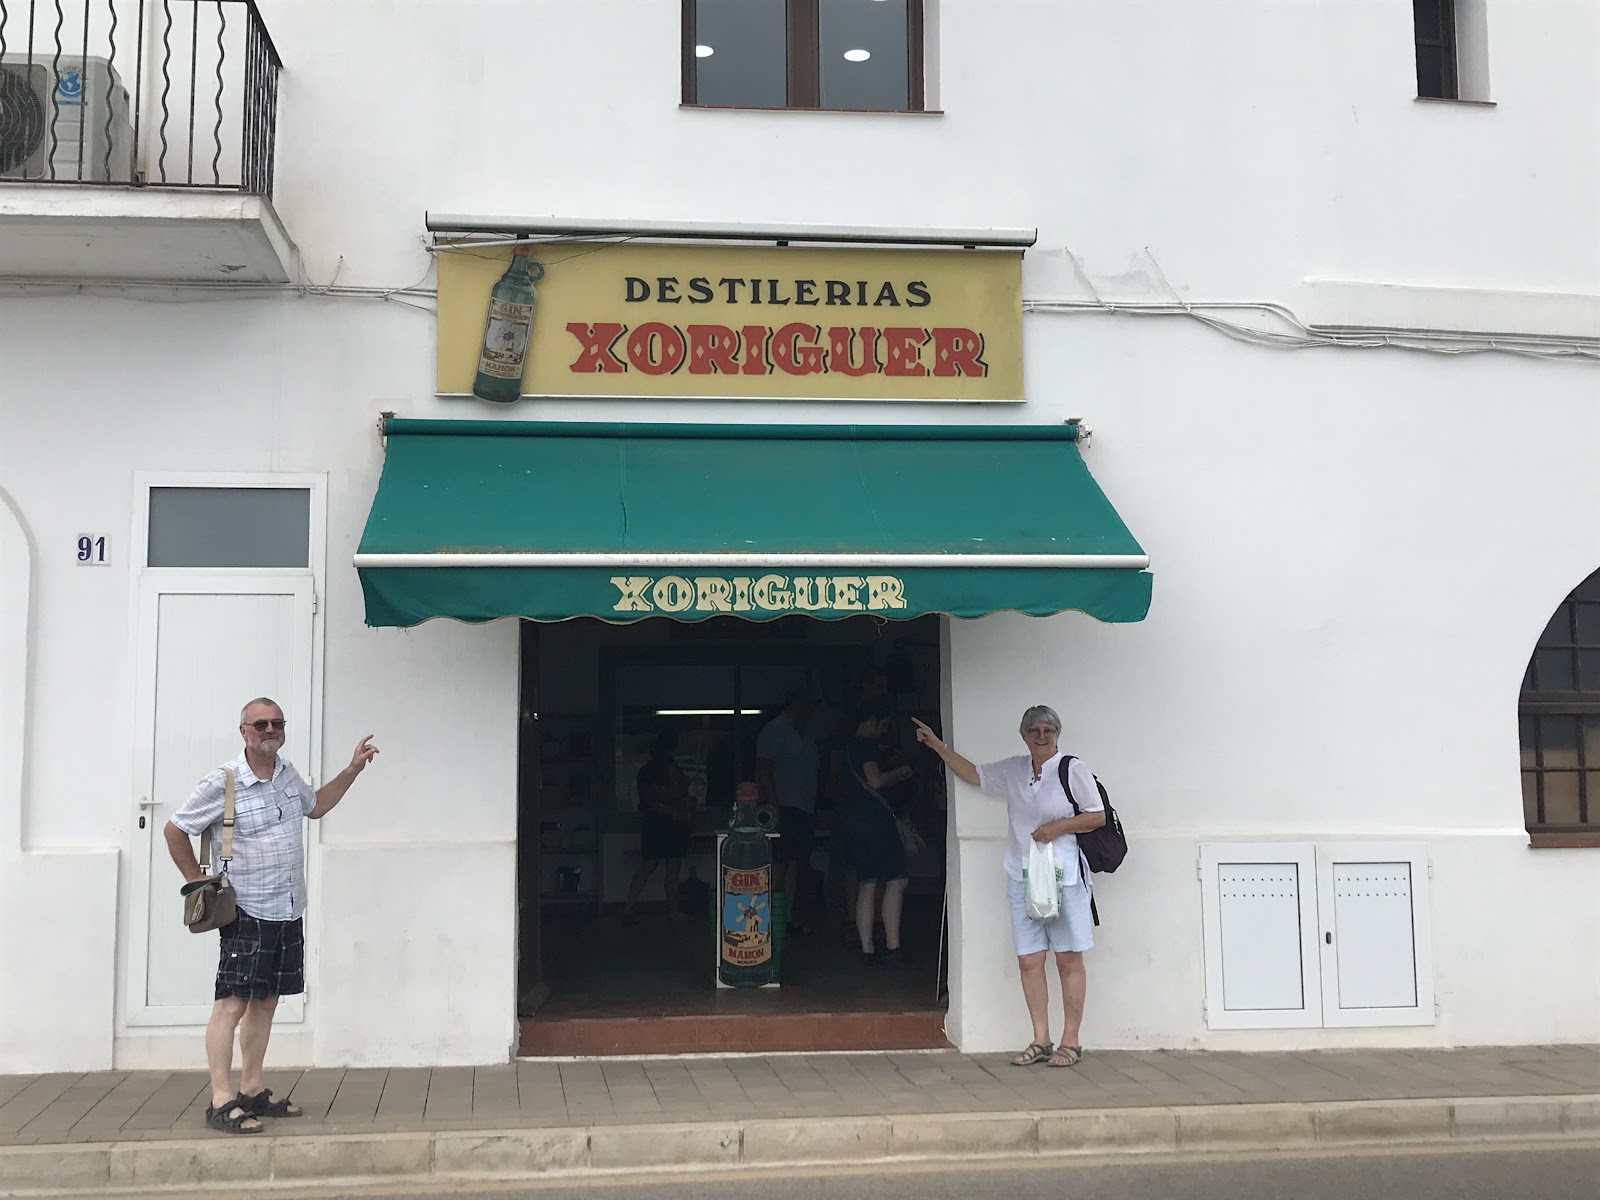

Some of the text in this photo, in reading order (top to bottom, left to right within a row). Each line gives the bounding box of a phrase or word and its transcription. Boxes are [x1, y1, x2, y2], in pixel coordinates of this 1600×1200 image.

[624, 276, 932, 308] DESTILERIAS
[500, 303, 522, 315] GIN
[566, 322, 988, 377] XORIGUER
[77, 536, 105, 562] 91
[610, 574, 907, 611] XORIGUER
[732, 873, 760, 886] GIN
[729, 948, 764, 959] MAHON
